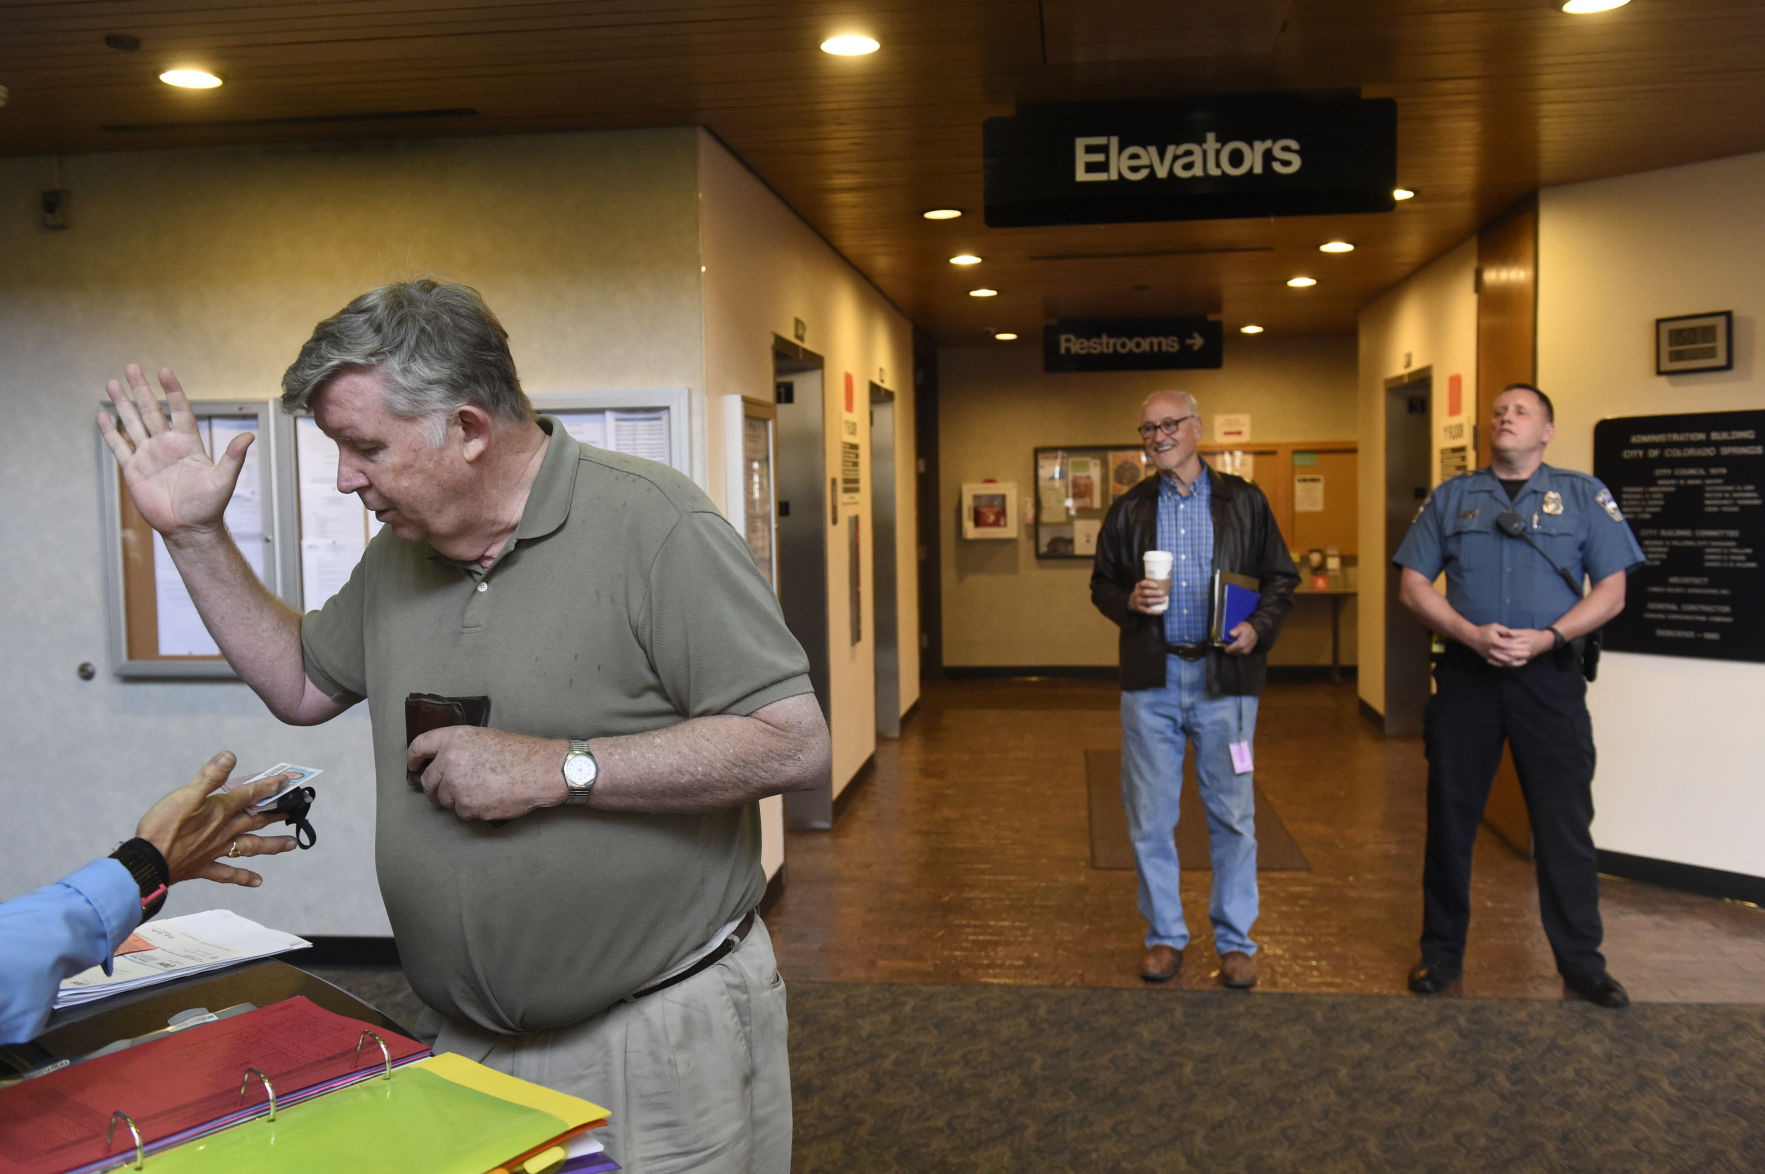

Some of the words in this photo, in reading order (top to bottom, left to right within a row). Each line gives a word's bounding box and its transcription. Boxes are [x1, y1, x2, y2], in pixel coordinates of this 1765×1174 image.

[1075, 132, 1302, 182] Elevators
[1059, 333, 1180, 355] Restrooms
[1630, 432, 1706, 444] ADMINISTRATION
[1710, 430, 1755, 440] BUILDING
[1622, 448, 1644, 459] CITY
[1647, 448, 1660, 458] OF
[1664, 446, 1717, 458] COLORADO
[1720, 445, 1763, 456] SPRINGS
